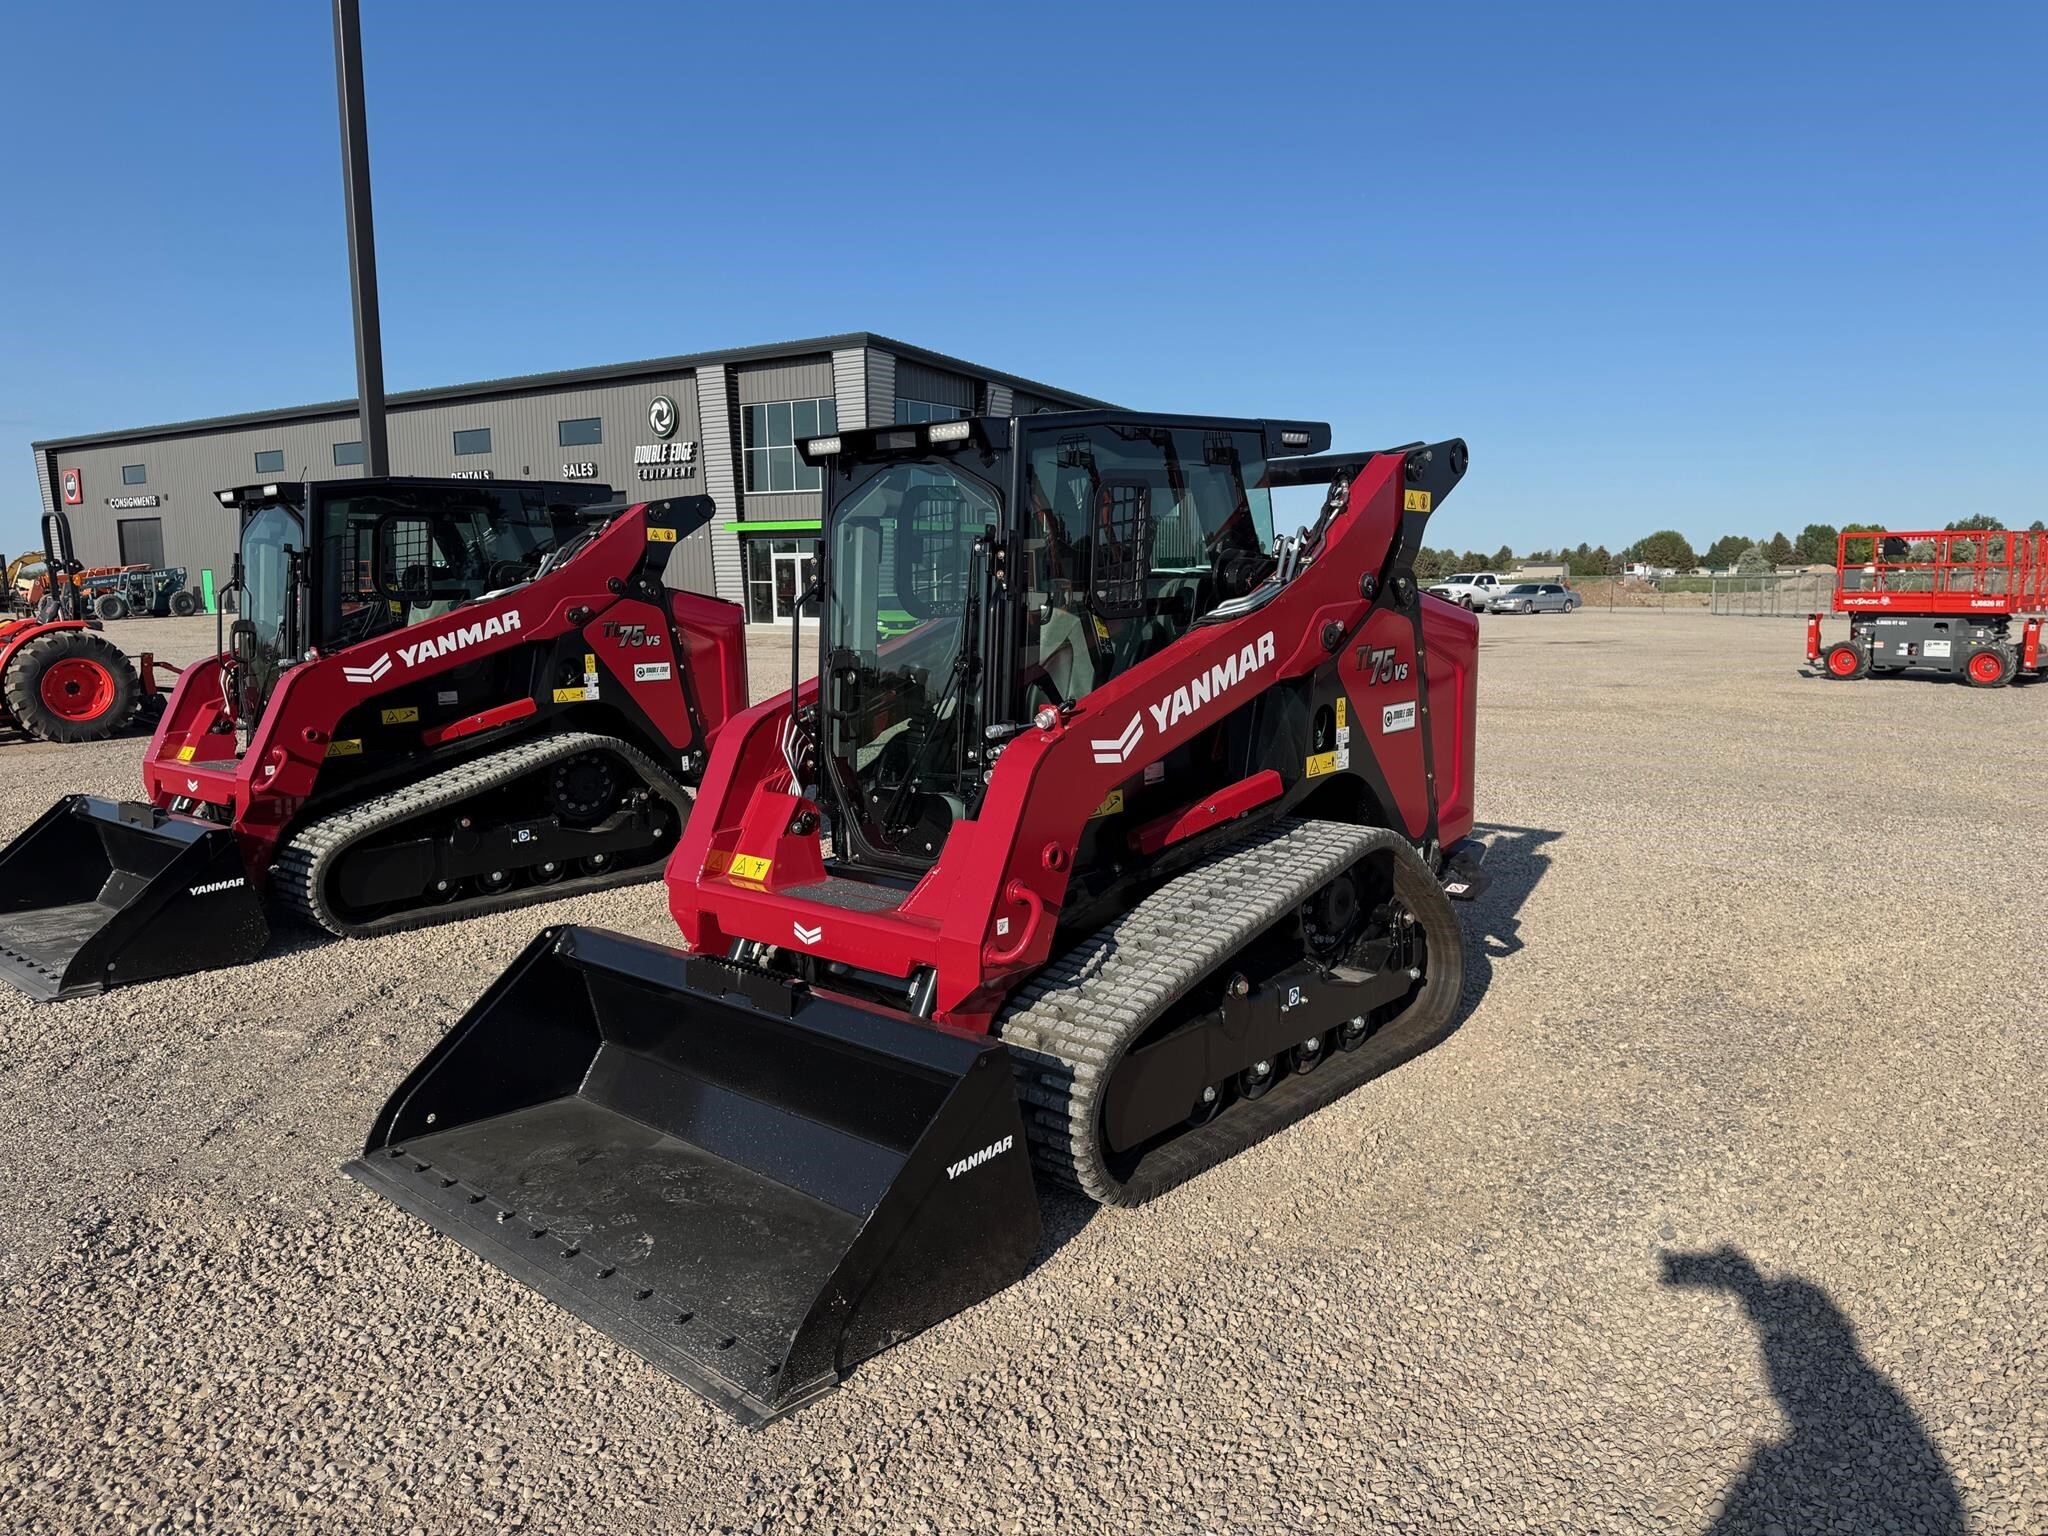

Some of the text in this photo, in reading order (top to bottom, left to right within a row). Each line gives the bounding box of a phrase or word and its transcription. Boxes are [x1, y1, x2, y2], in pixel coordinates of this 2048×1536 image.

[634, 441, 694, 464] DOUBLE EDGE
[562, 462, 594, 478] SALES
[637, 466, 692, 480] EQUIPMENT
[110, 495, 157, 509] CONSIGNMENTS
[1843, 597, 1879, 606] SKYJACK
[396, 609, 521, 668] YANMAR
[1148, 630, 1275, 734] YANMAR
[189, 877, 245, 896] YANMAR
[946, 1134, 1013, 1181] YANMAR
